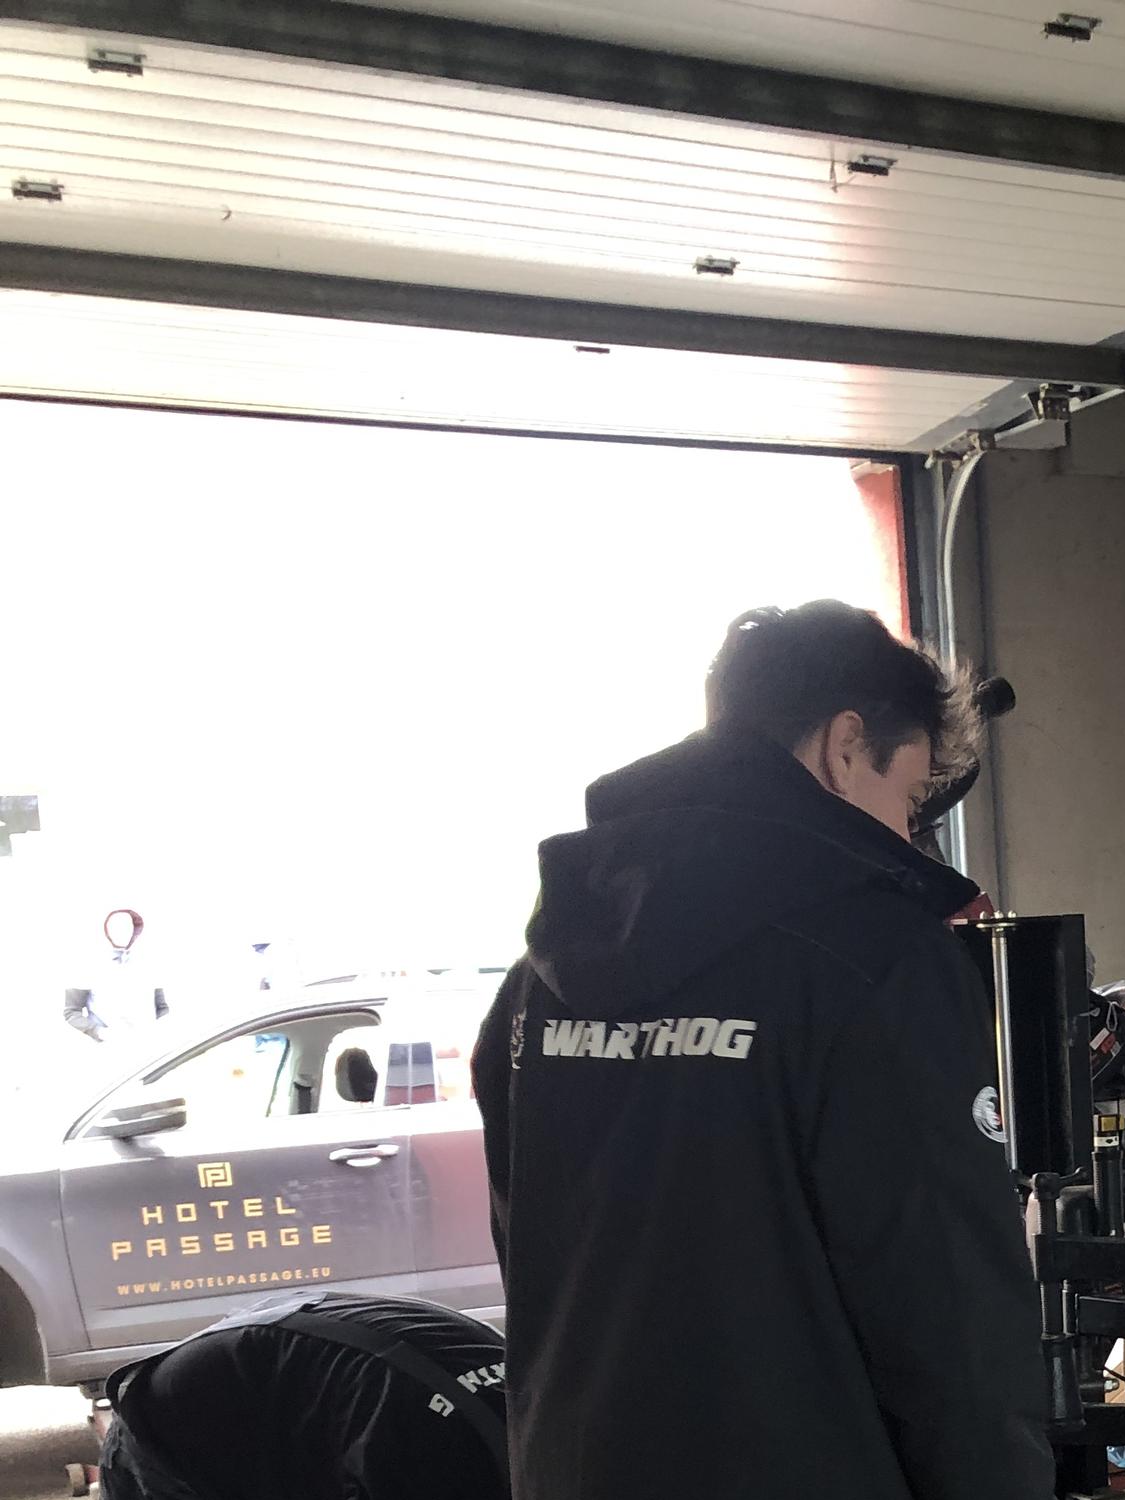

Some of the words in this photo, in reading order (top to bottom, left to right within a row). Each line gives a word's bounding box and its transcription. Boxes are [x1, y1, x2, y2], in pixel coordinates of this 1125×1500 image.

[542, 1017, 757, 1060] WARTHOG
[142, 1197, 296, 1225] HOTEL
[111, 1225, 332, 1261] PASSAGE
[117, 1266, 331, 1296] WWW.HOTELPASSAGE.EU
